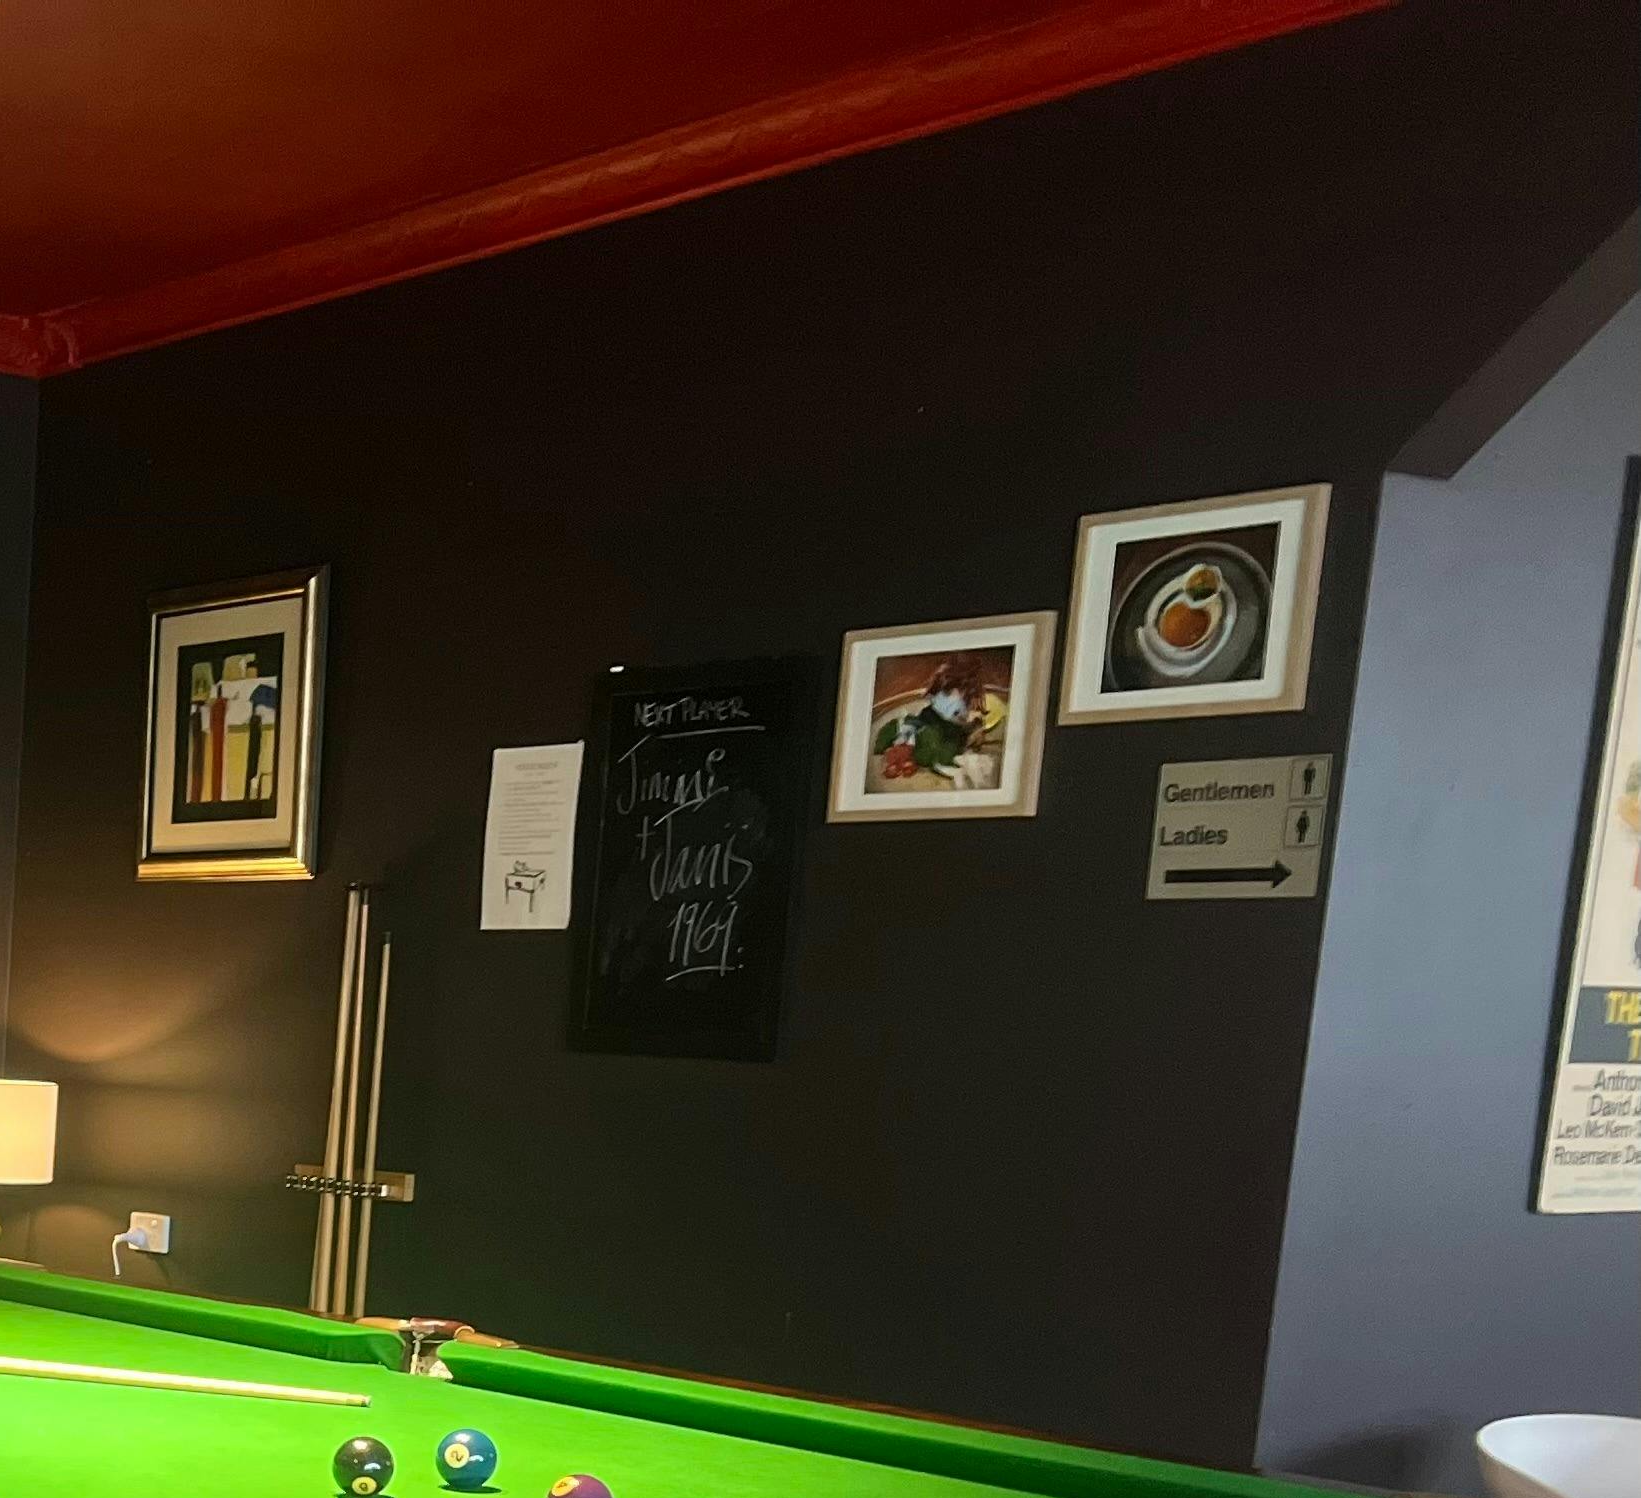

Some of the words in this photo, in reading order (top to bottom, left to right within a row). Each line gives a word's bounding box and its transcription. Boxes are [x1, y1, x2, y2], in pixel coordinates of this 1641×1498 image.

[1164, 781, 1275, 803] Gentlemen
[1159, 824, 1229, 847] Ladies
[1588, 1093, 1633, 1117] David
[1556, 1118, 1583, 1138] Leo
